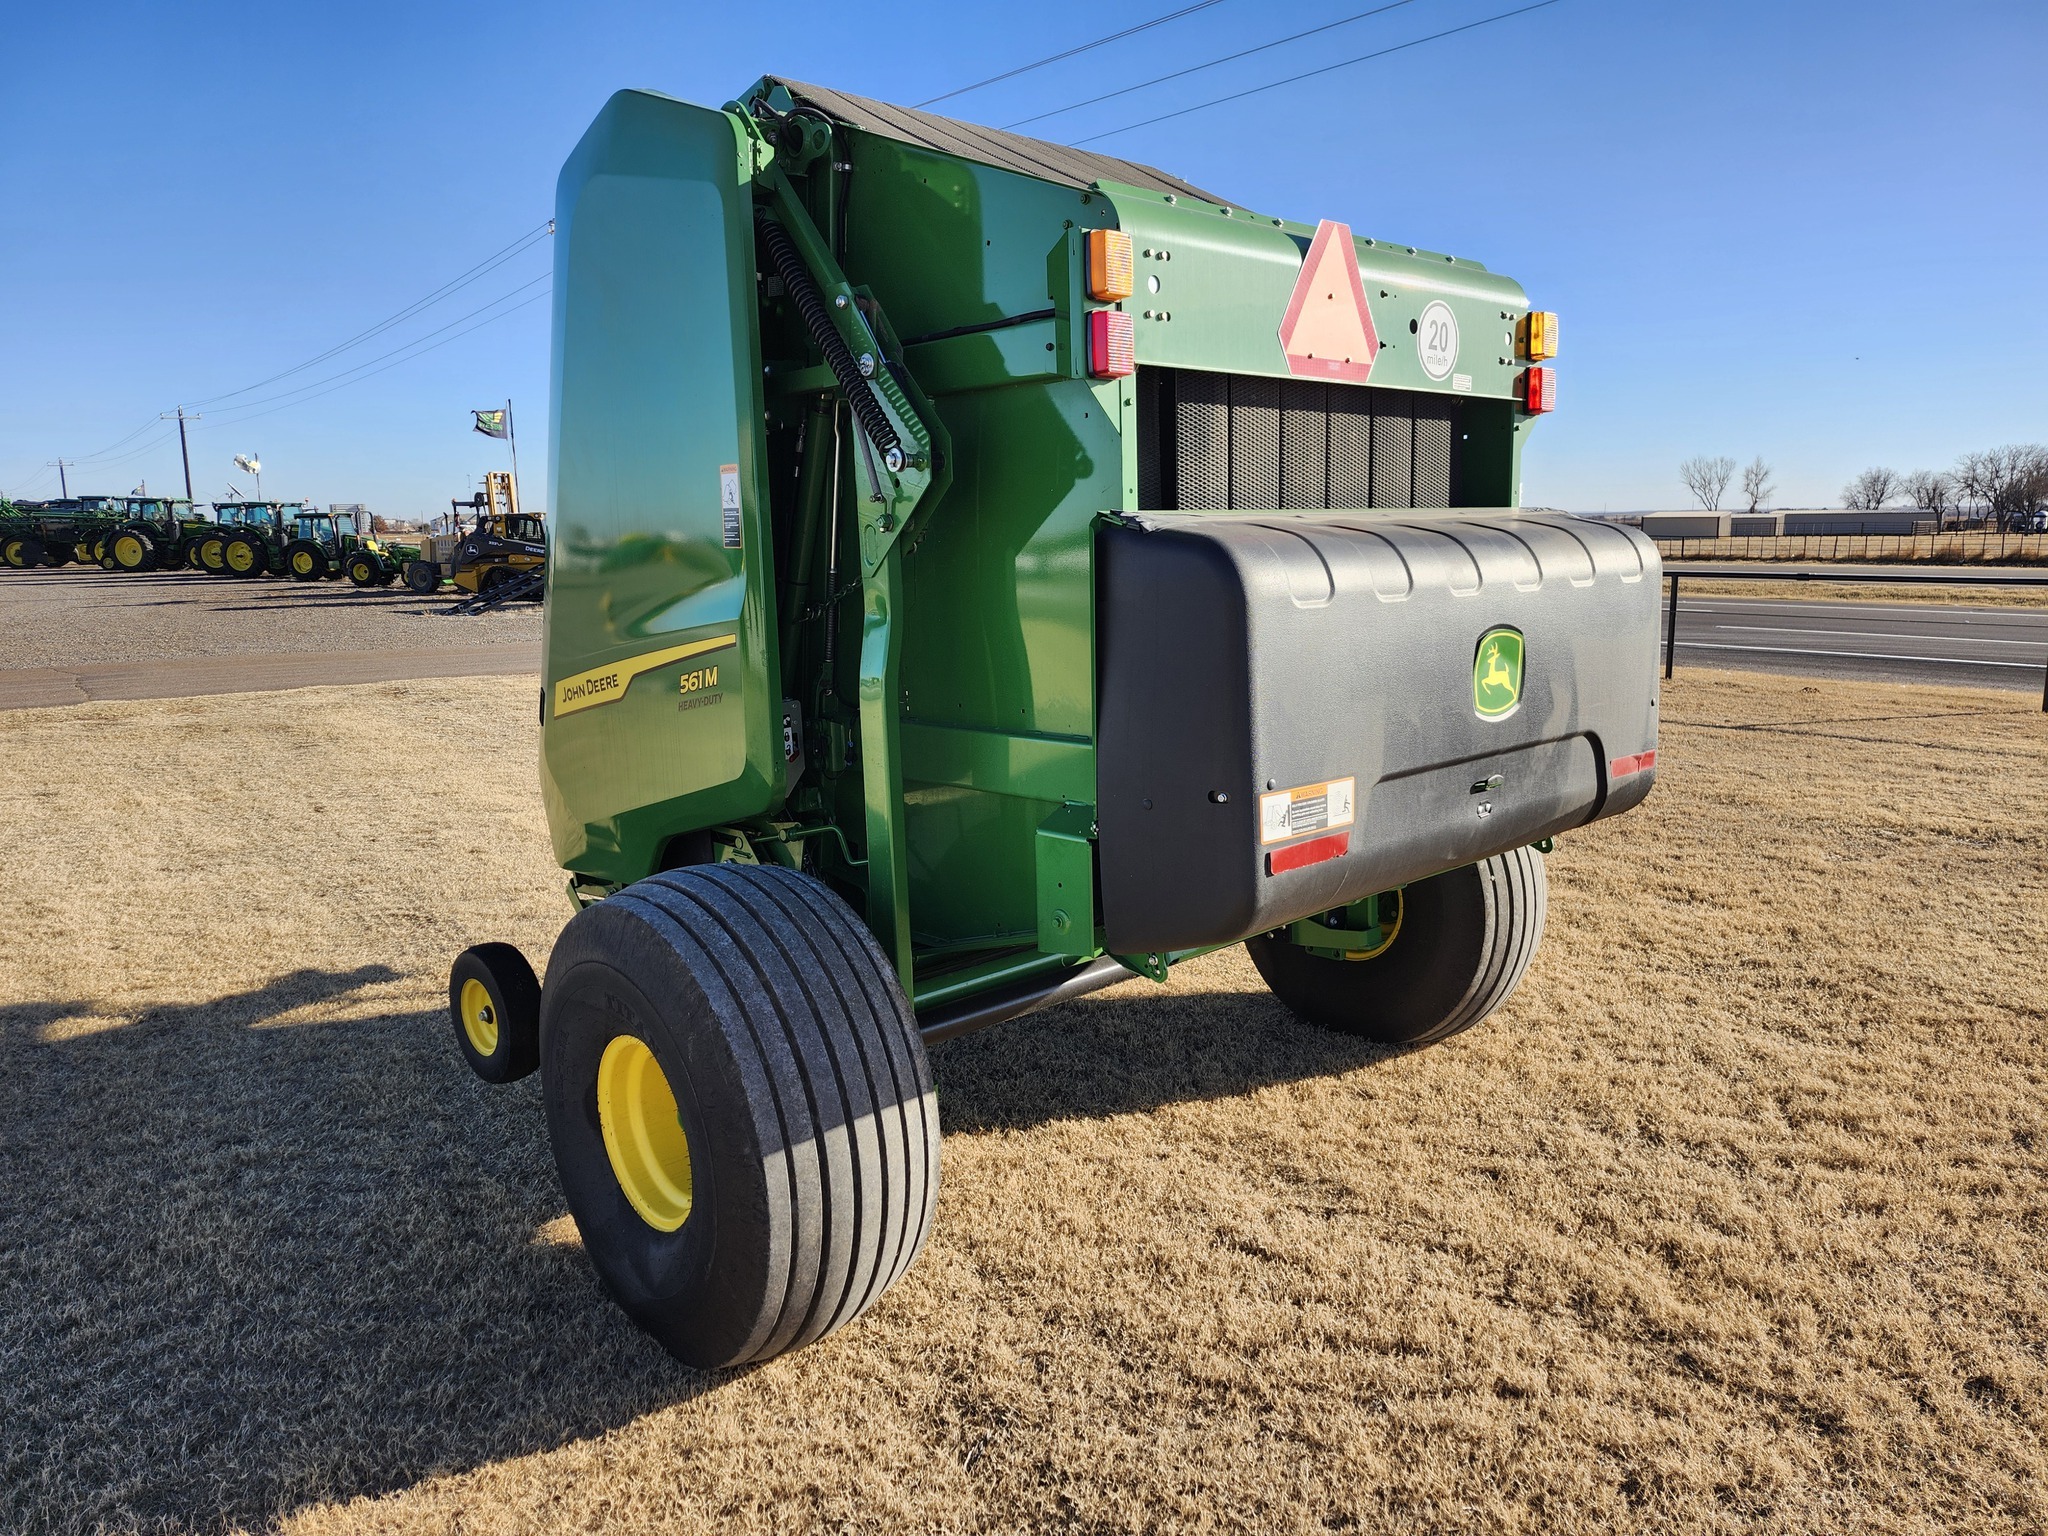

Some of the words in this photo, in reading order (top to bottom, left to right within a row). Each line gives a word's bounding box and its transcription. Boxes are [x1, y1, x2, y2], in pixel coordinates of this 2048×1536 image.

[1428, 319, 1448, 352] 20
[563, 684, 585, 703] JOHN
[586, 673, 619, 695] DEERE
[678, 693, 723, 712] HEAVY-DUTY
